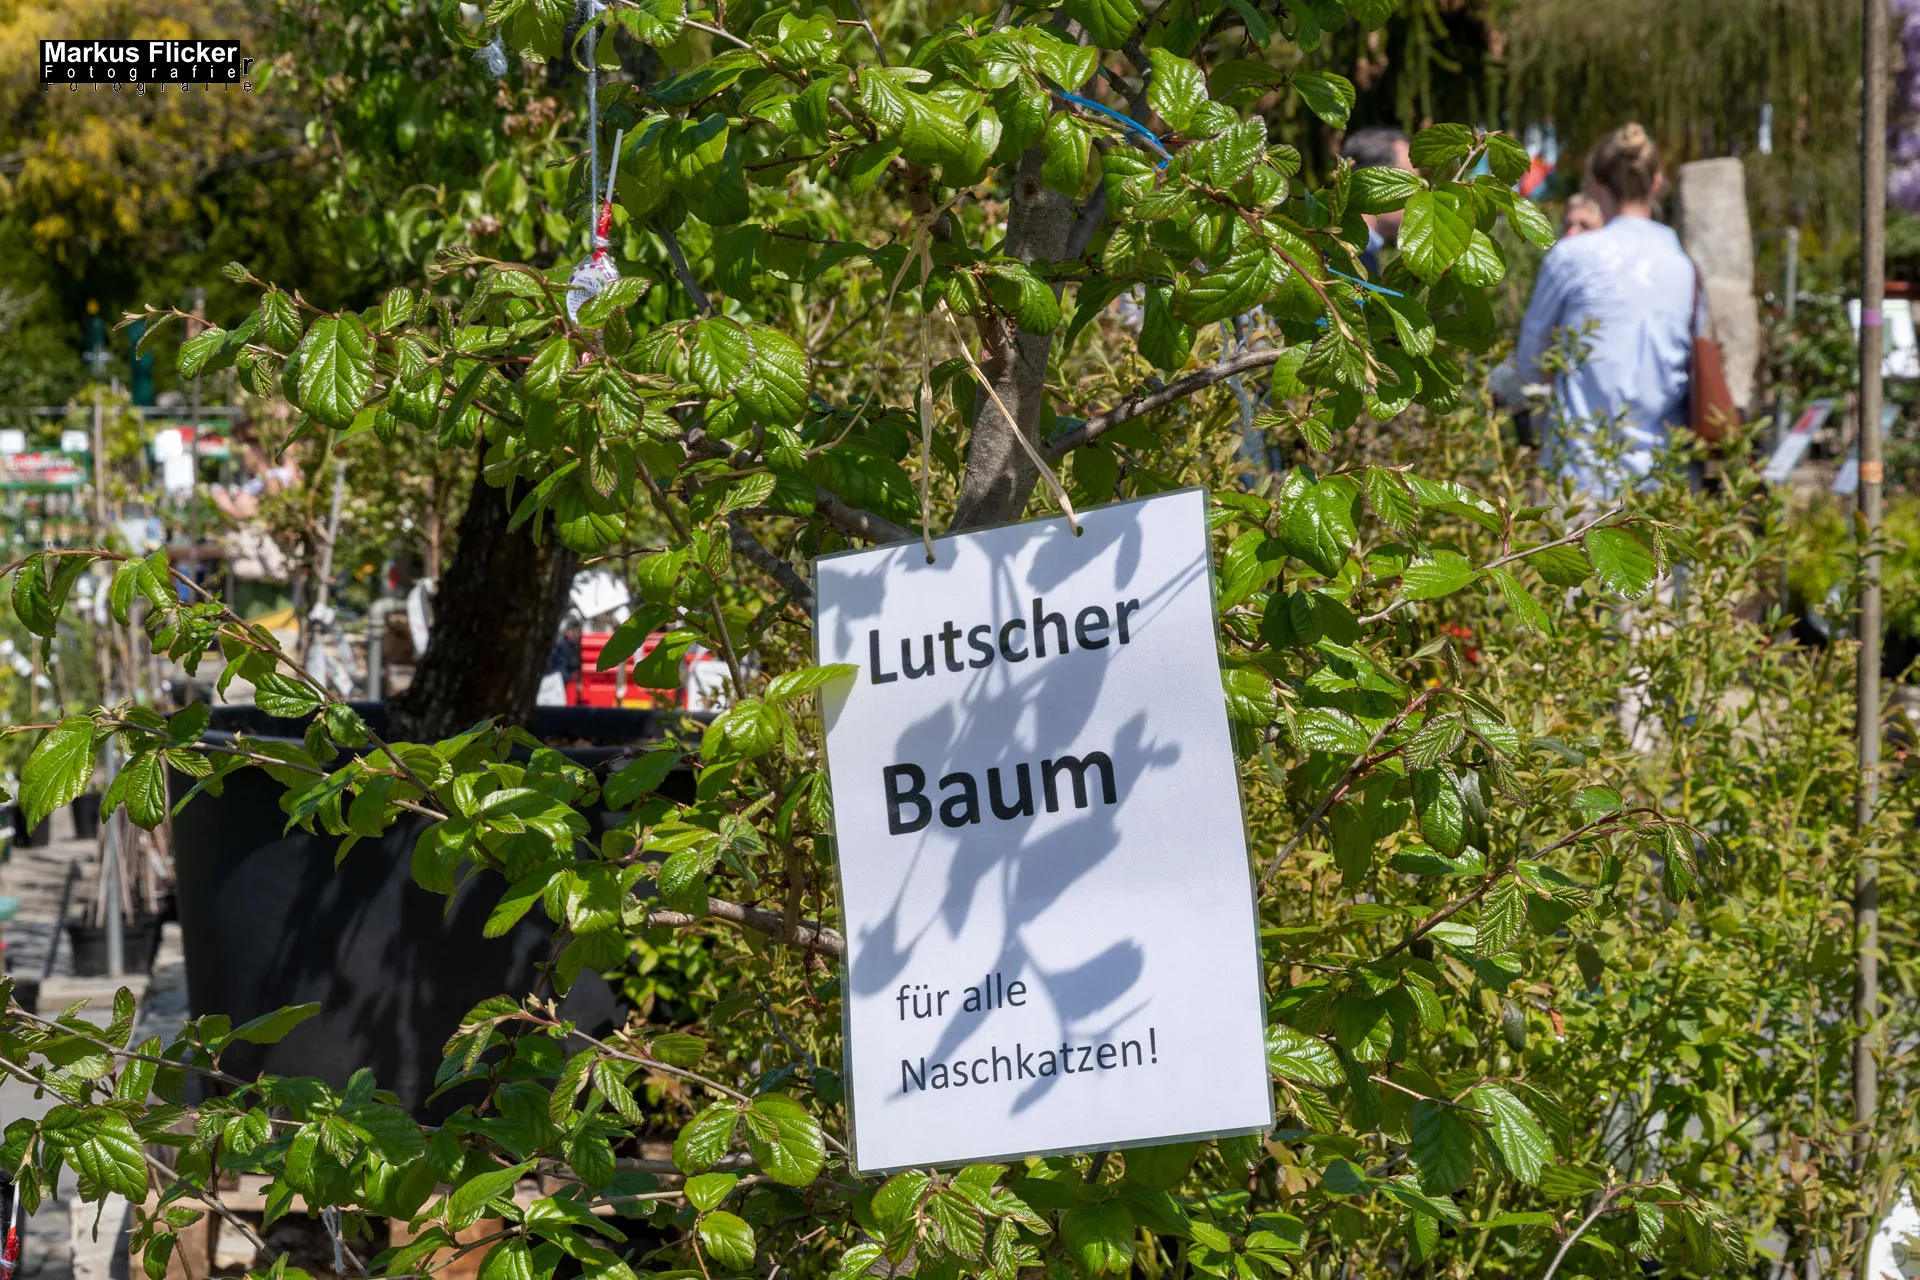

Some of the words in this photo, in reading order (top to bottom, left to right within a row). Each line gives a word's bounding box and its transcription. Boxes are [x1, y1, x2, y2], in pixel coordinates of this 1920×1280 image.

[869, 597, 1140, 685] Lutscher
[883, 751, 1118, 836] Baum
[896, 984, 950, 1021] für
[963, 972, 1027, 1013] alle
[901, 1027, 1159, 1094] Naschkatzen!
